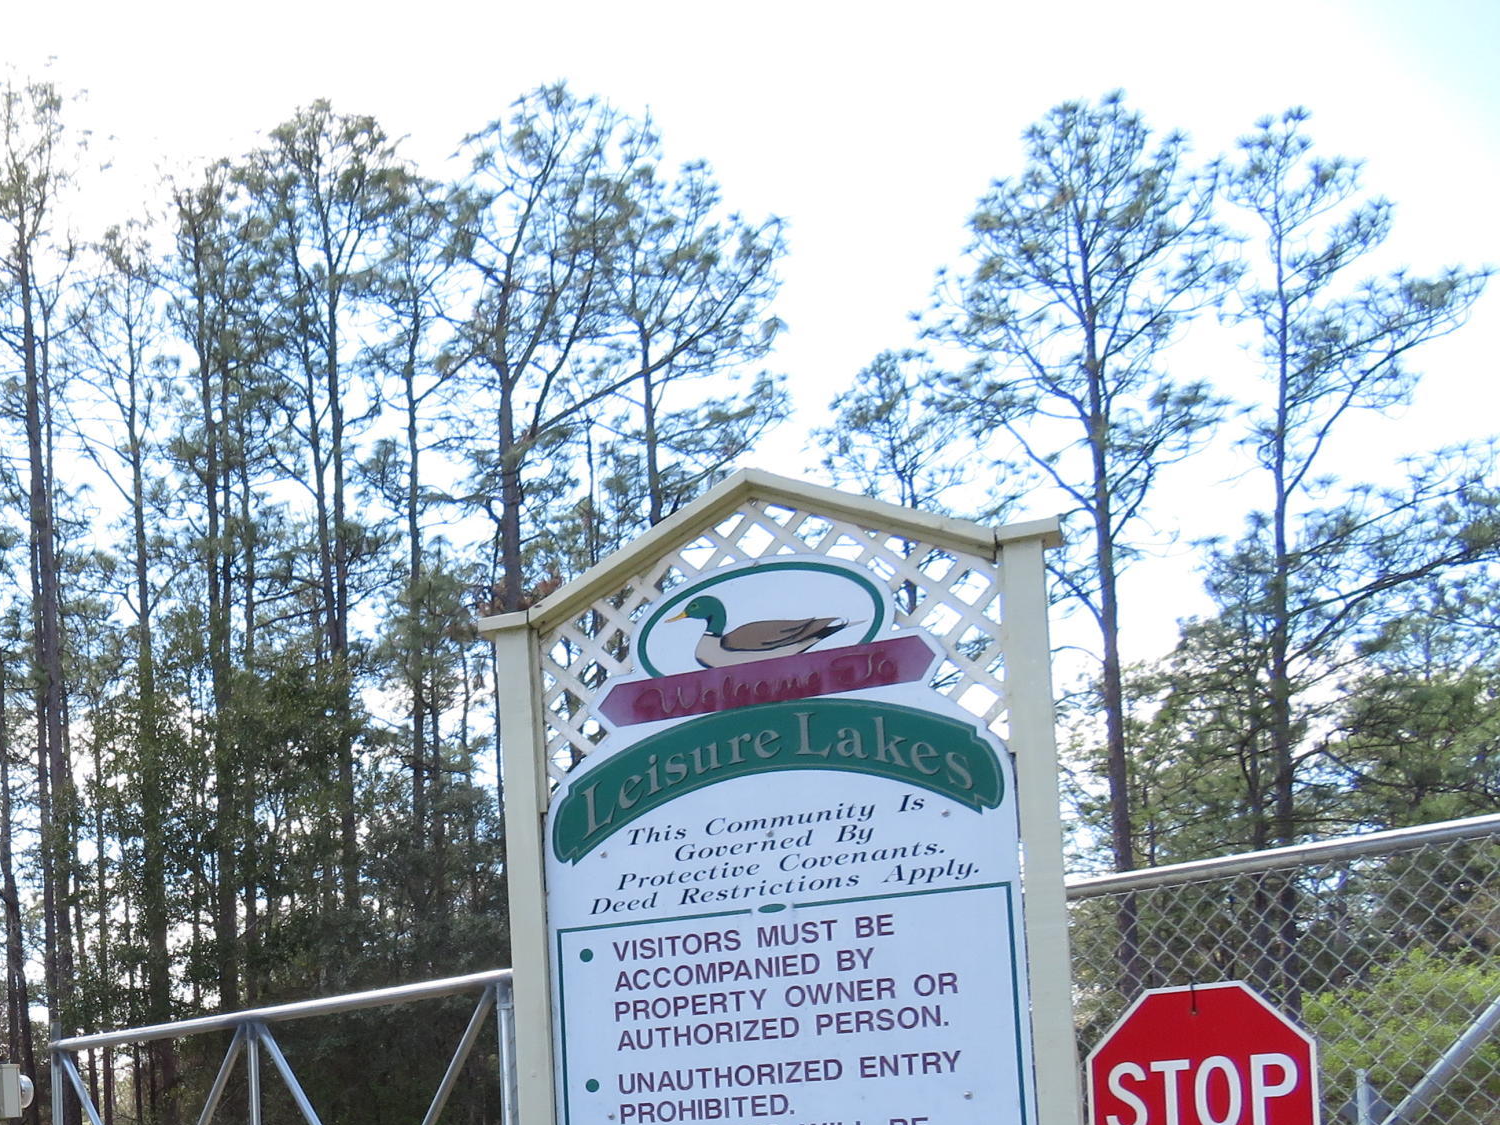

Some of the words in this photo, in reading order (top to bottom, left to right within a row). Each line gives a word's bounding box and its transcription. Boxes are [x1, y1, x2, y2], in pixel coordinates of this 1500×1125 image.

[831, 650, 896, 684] To
[581, 728, 782, 840] Leisure
[793, 712, 975, 791] Lakes
[628, 825, 686, 846] This
[706, 802, 875, 836] Community
[898, 794, 925, 812] Is
[675, 830, 812, 862] Governed
[836, 824, 873, 846] By
[590, 893, 657, 916] Deed
[681, 872, 859, 906] Restrictions
[884, 860, 980, 887] Apply.
[617, 862, 760, 891] Protective
[779, 843, 946, 872] Covenants.
[612, 930, 741, 962] VISITORS
[756, 919, 838, 948] MUST
[856, 914, 895, 939] BE
[615, 953, 820, 992] ACCOMPANIED
[837, 947, 874, 971] BY
[614, 989, 766, 1022] PROPERTY
[785, 977, 895, 1008] OWNER
[914, 973, 958, 997] OR
[617, 1016, 799, 1051] AUTHORIZED
[816, 1005, 949, 1036] PERSON.
[618, 1059, 843, 1094] UNAUTHORIZED
[860, 1051, 961, 1079] ENTRY
[620, 1094, 795, 1125] PROHIBITED.
